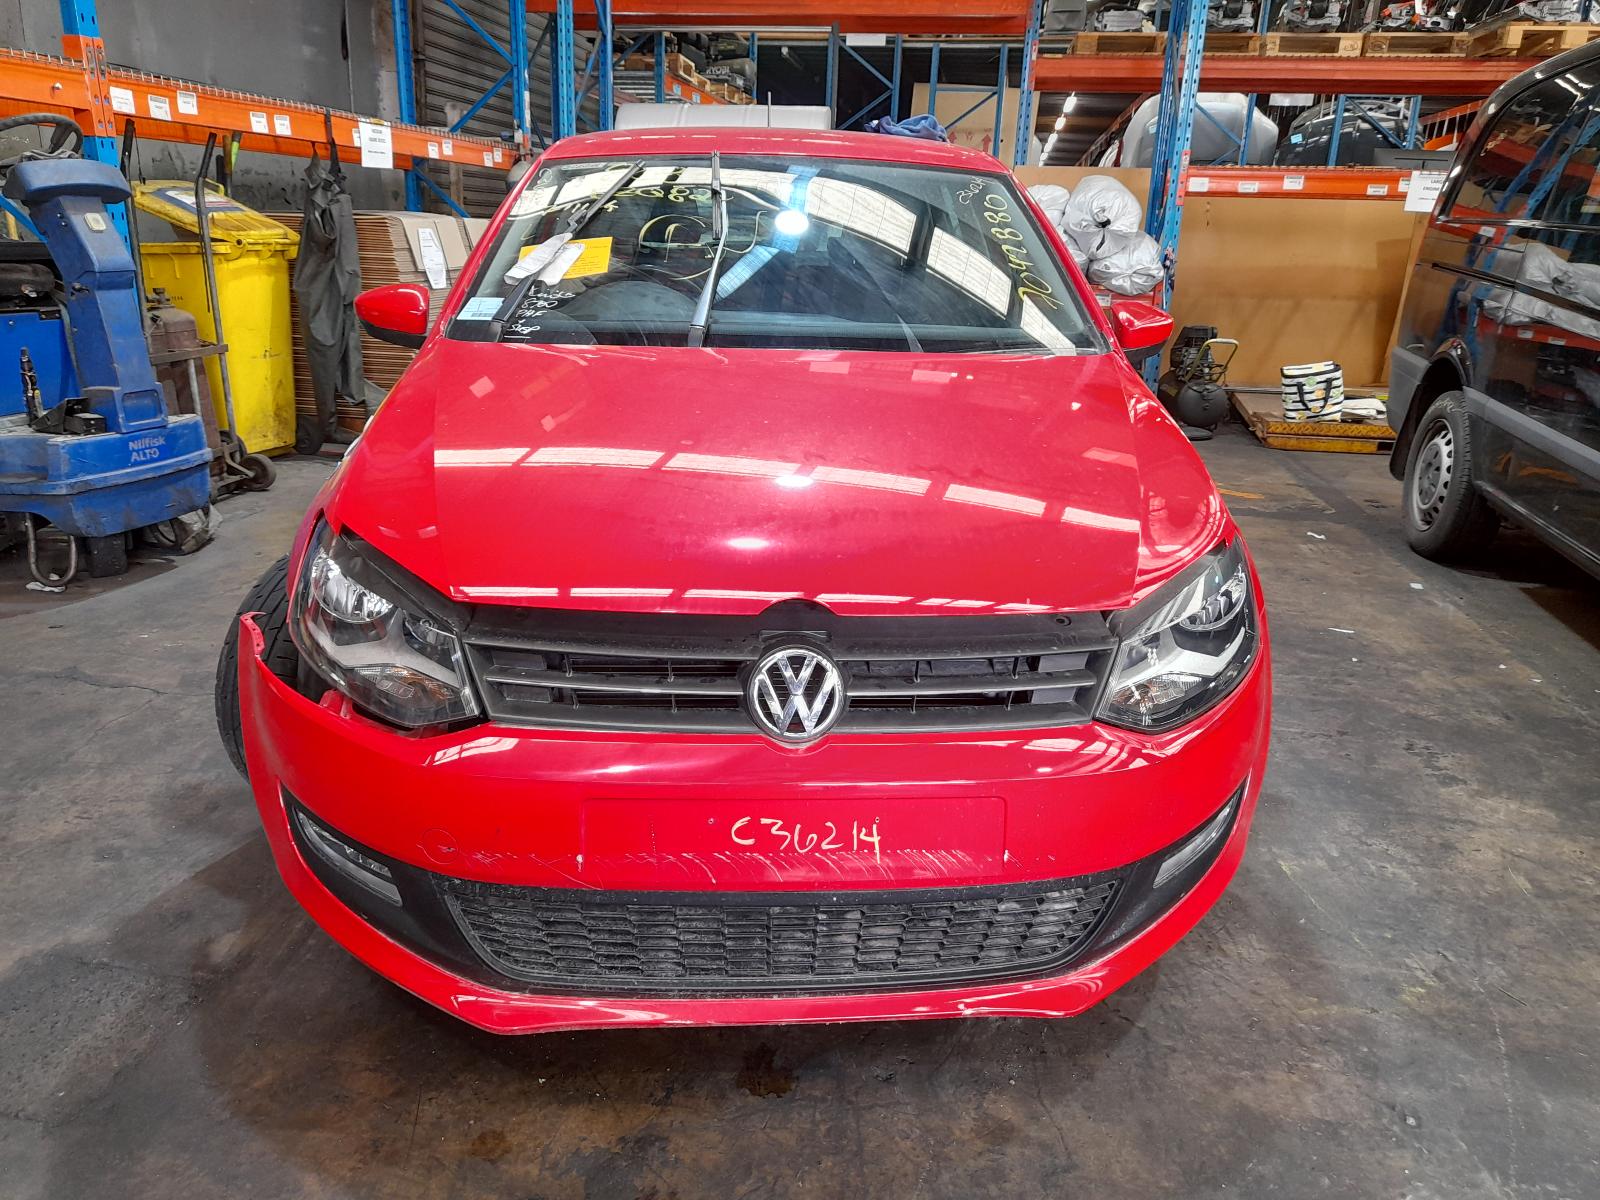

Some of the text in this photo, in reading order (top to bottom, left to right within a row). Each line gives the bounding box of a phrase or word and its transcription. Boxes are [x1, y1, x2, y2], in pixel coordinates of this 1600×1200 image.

[128, 436, 166, 451] Nilfisk
[131, 448, 160, 462] ALTO
[731, 816, 882, 864] C36214
